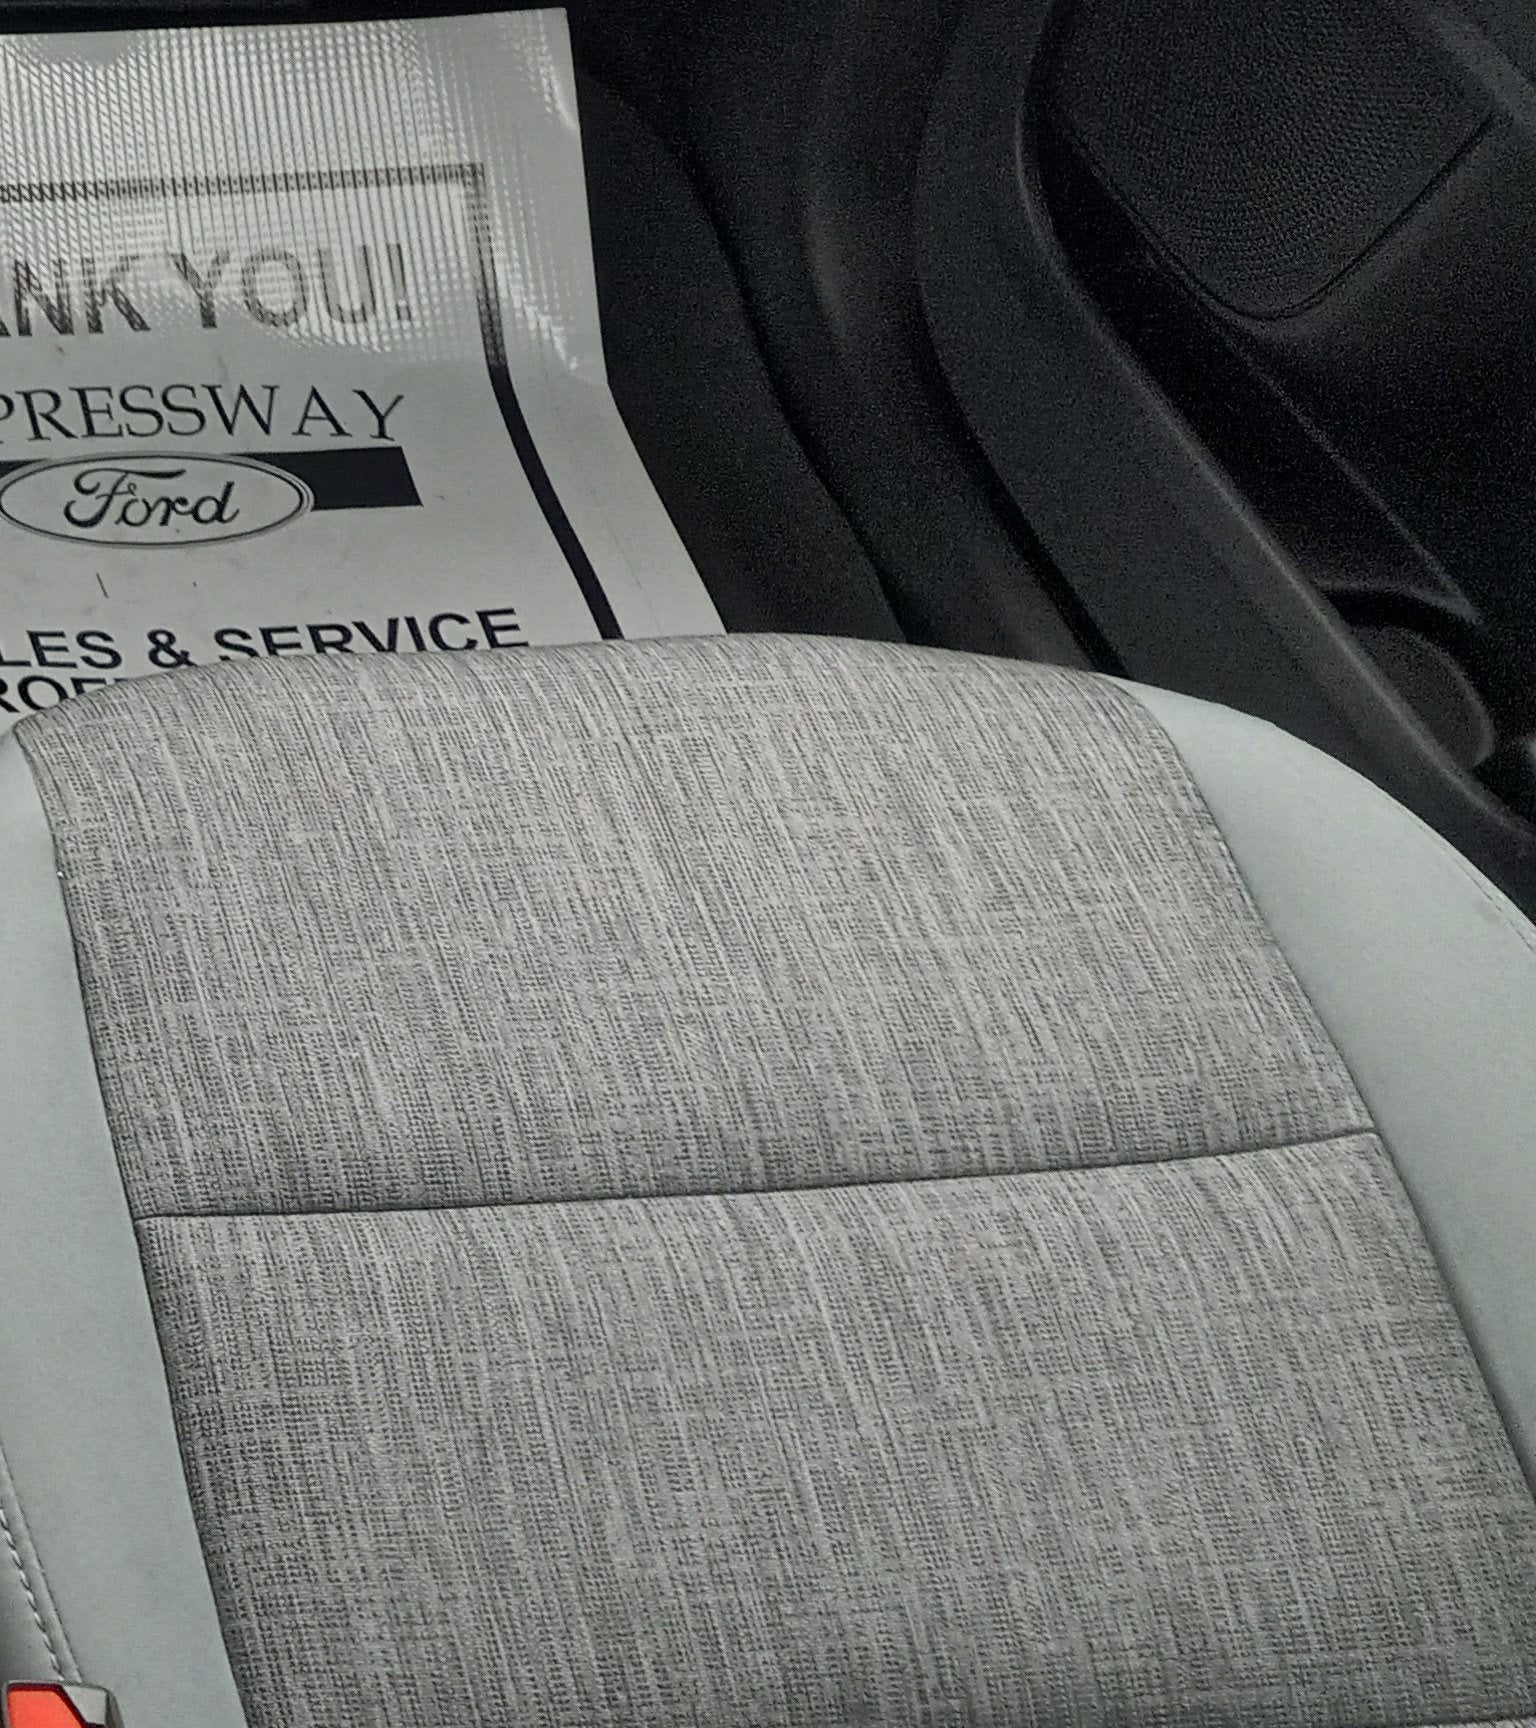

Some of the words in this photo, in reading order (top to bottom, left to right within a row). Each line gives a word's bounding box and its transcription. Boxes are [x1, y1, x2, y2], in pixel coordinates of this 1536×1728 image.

[170, 240, 415, 330] YOU!
[64, 467, 242, 536] Ford
[147, 628, 199, 668] &
[213, 607, 529, 663] SERVICE
